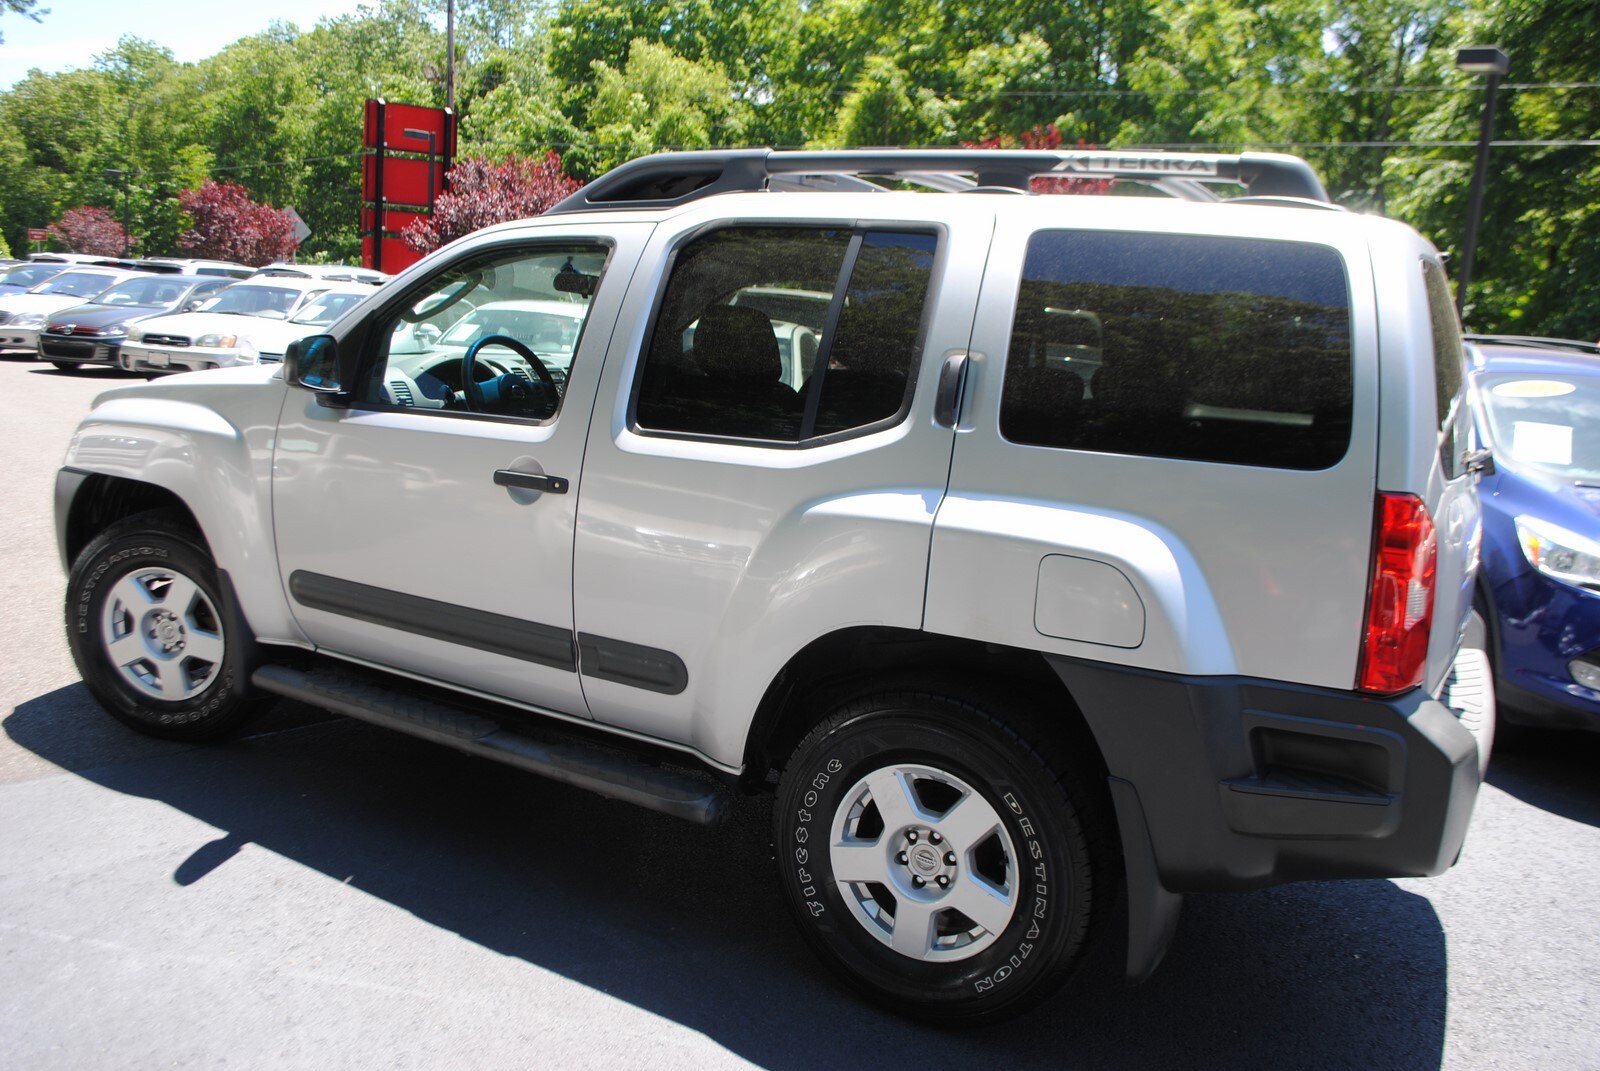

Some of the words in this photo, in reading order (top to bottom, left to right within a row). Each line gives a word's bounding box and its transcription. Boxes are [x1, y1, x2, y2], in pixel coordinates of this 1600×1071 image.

[1051, 154, 1214, 173] XTERRA
[78, 547, 168, 633] DESTINATION
[796, 758, 842, 916] Firestone
[974, 792, 1047, 992] DESTINATION
